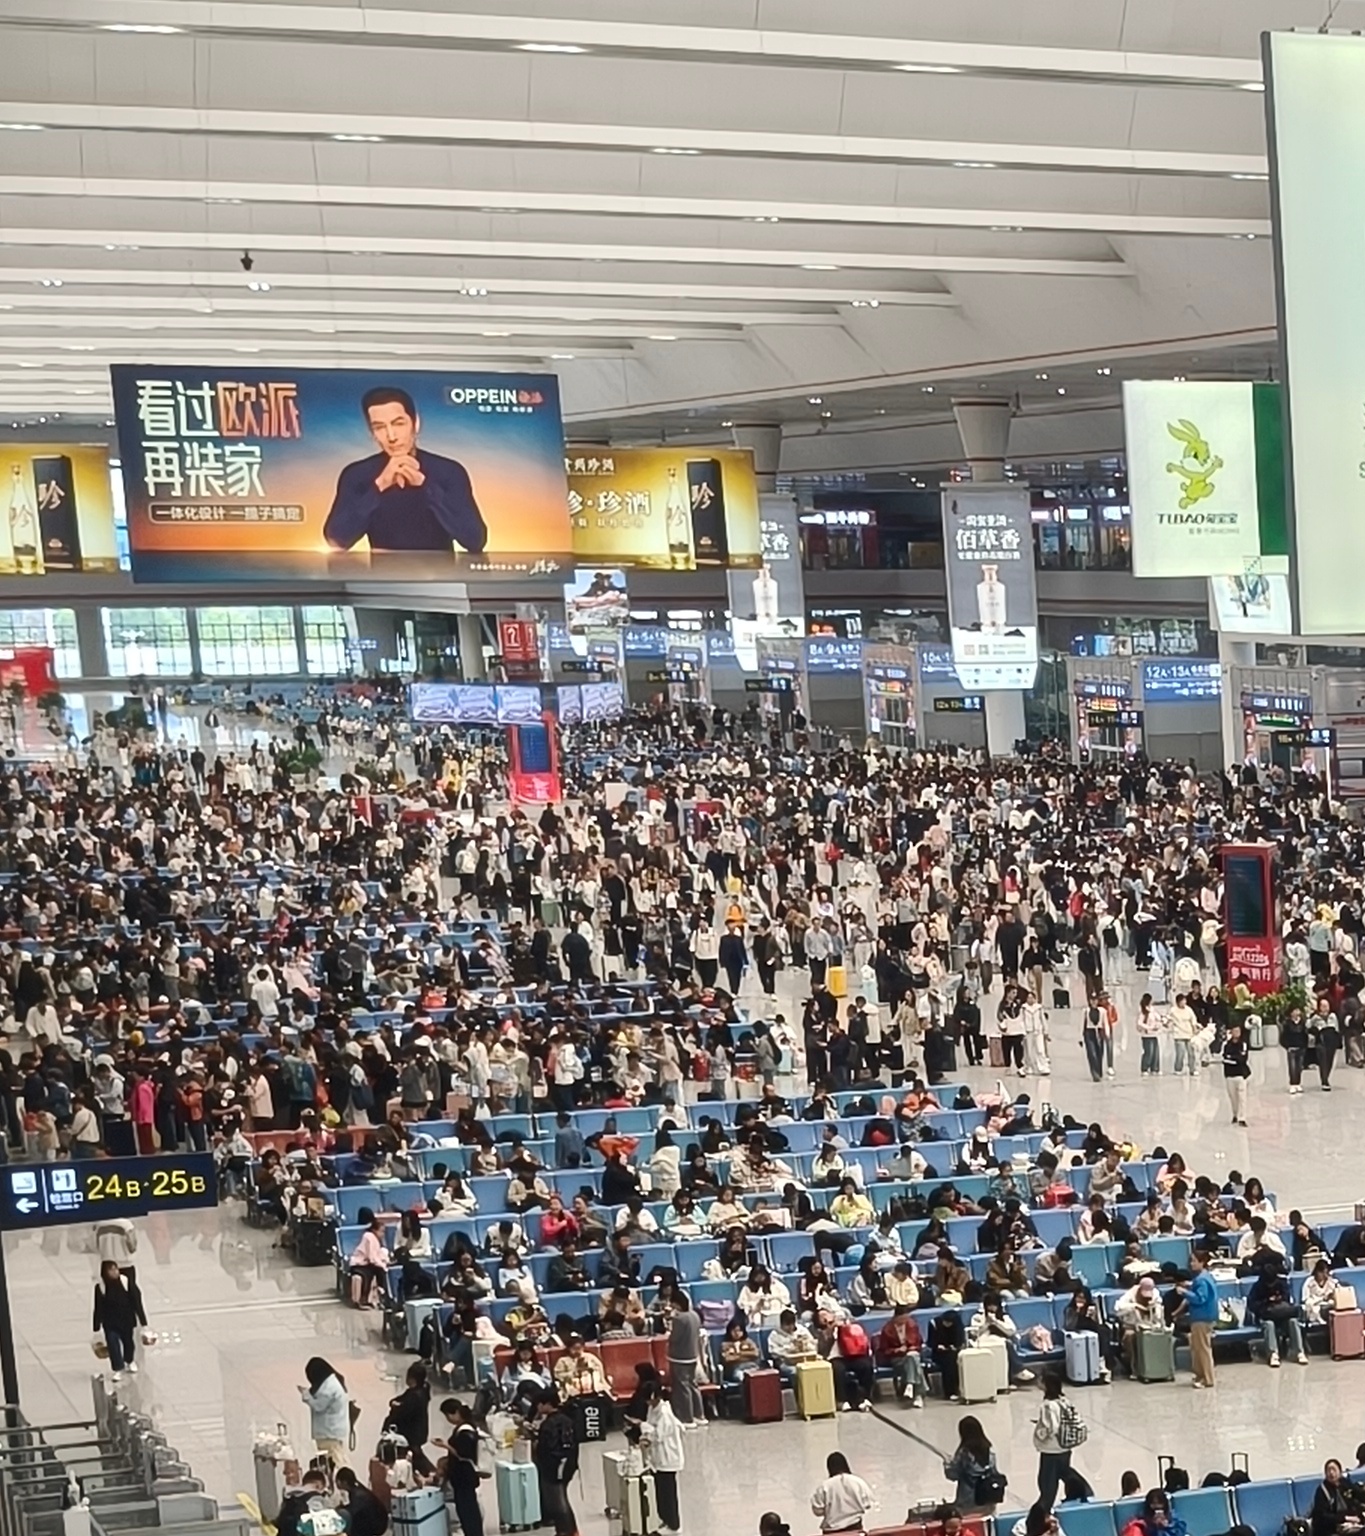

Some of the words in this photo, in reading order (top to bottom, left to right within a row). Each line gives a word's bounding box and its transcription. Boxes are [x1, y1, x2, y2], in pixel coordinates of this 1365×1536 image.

[135, 379, 301, 438] 看过欧派
[450, 388, 517, 404] OPPEIN
[141, 440, 266, 497] 再装家
[86, 1169, 206, 1200] 24B·25B
